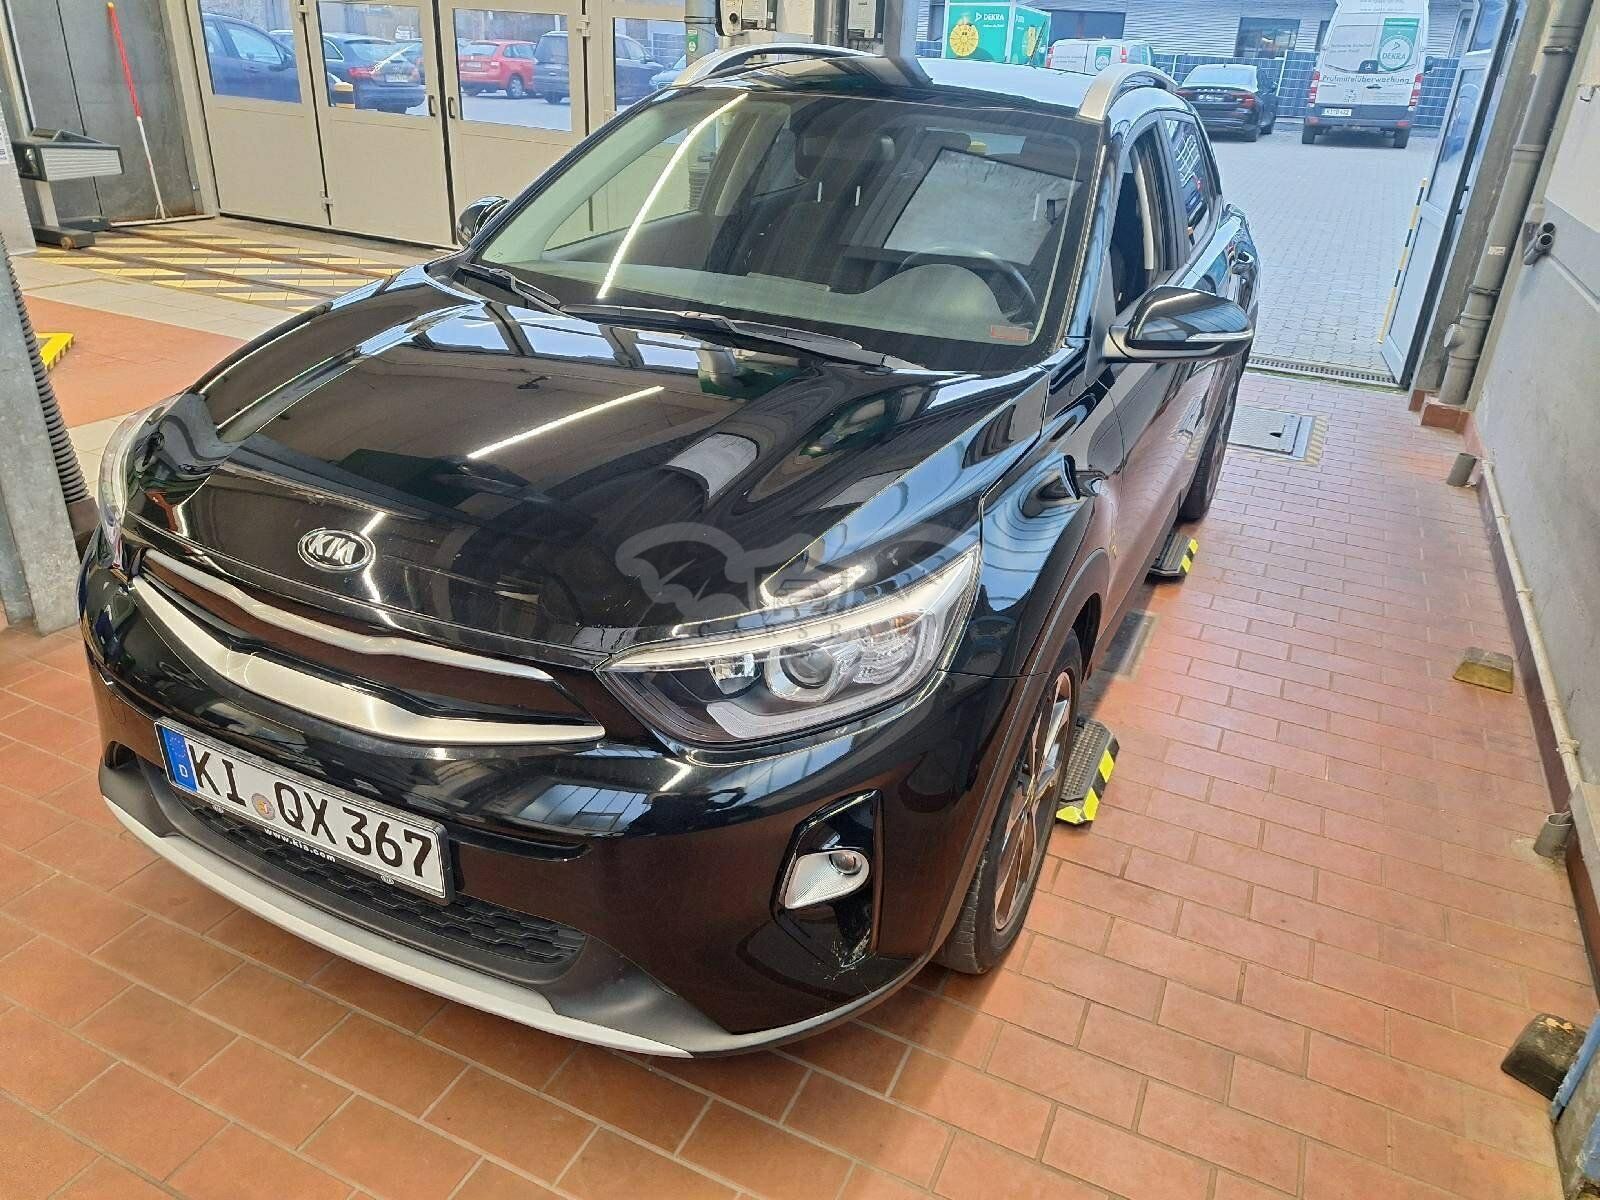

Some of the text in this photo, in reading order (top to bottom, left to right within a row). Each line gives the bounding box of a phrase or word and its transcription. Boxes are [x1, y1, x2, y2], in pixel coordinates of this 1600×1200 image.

[983, 13, 1005, 21] DEKRA
[309, 533, 356, 564] KIA
[189, 744, 247, 807] KI
[273, 781, 337, 845] QX
[342, 806, 432, 877] 367
[263, 828, 336, 862] www.kia.com
